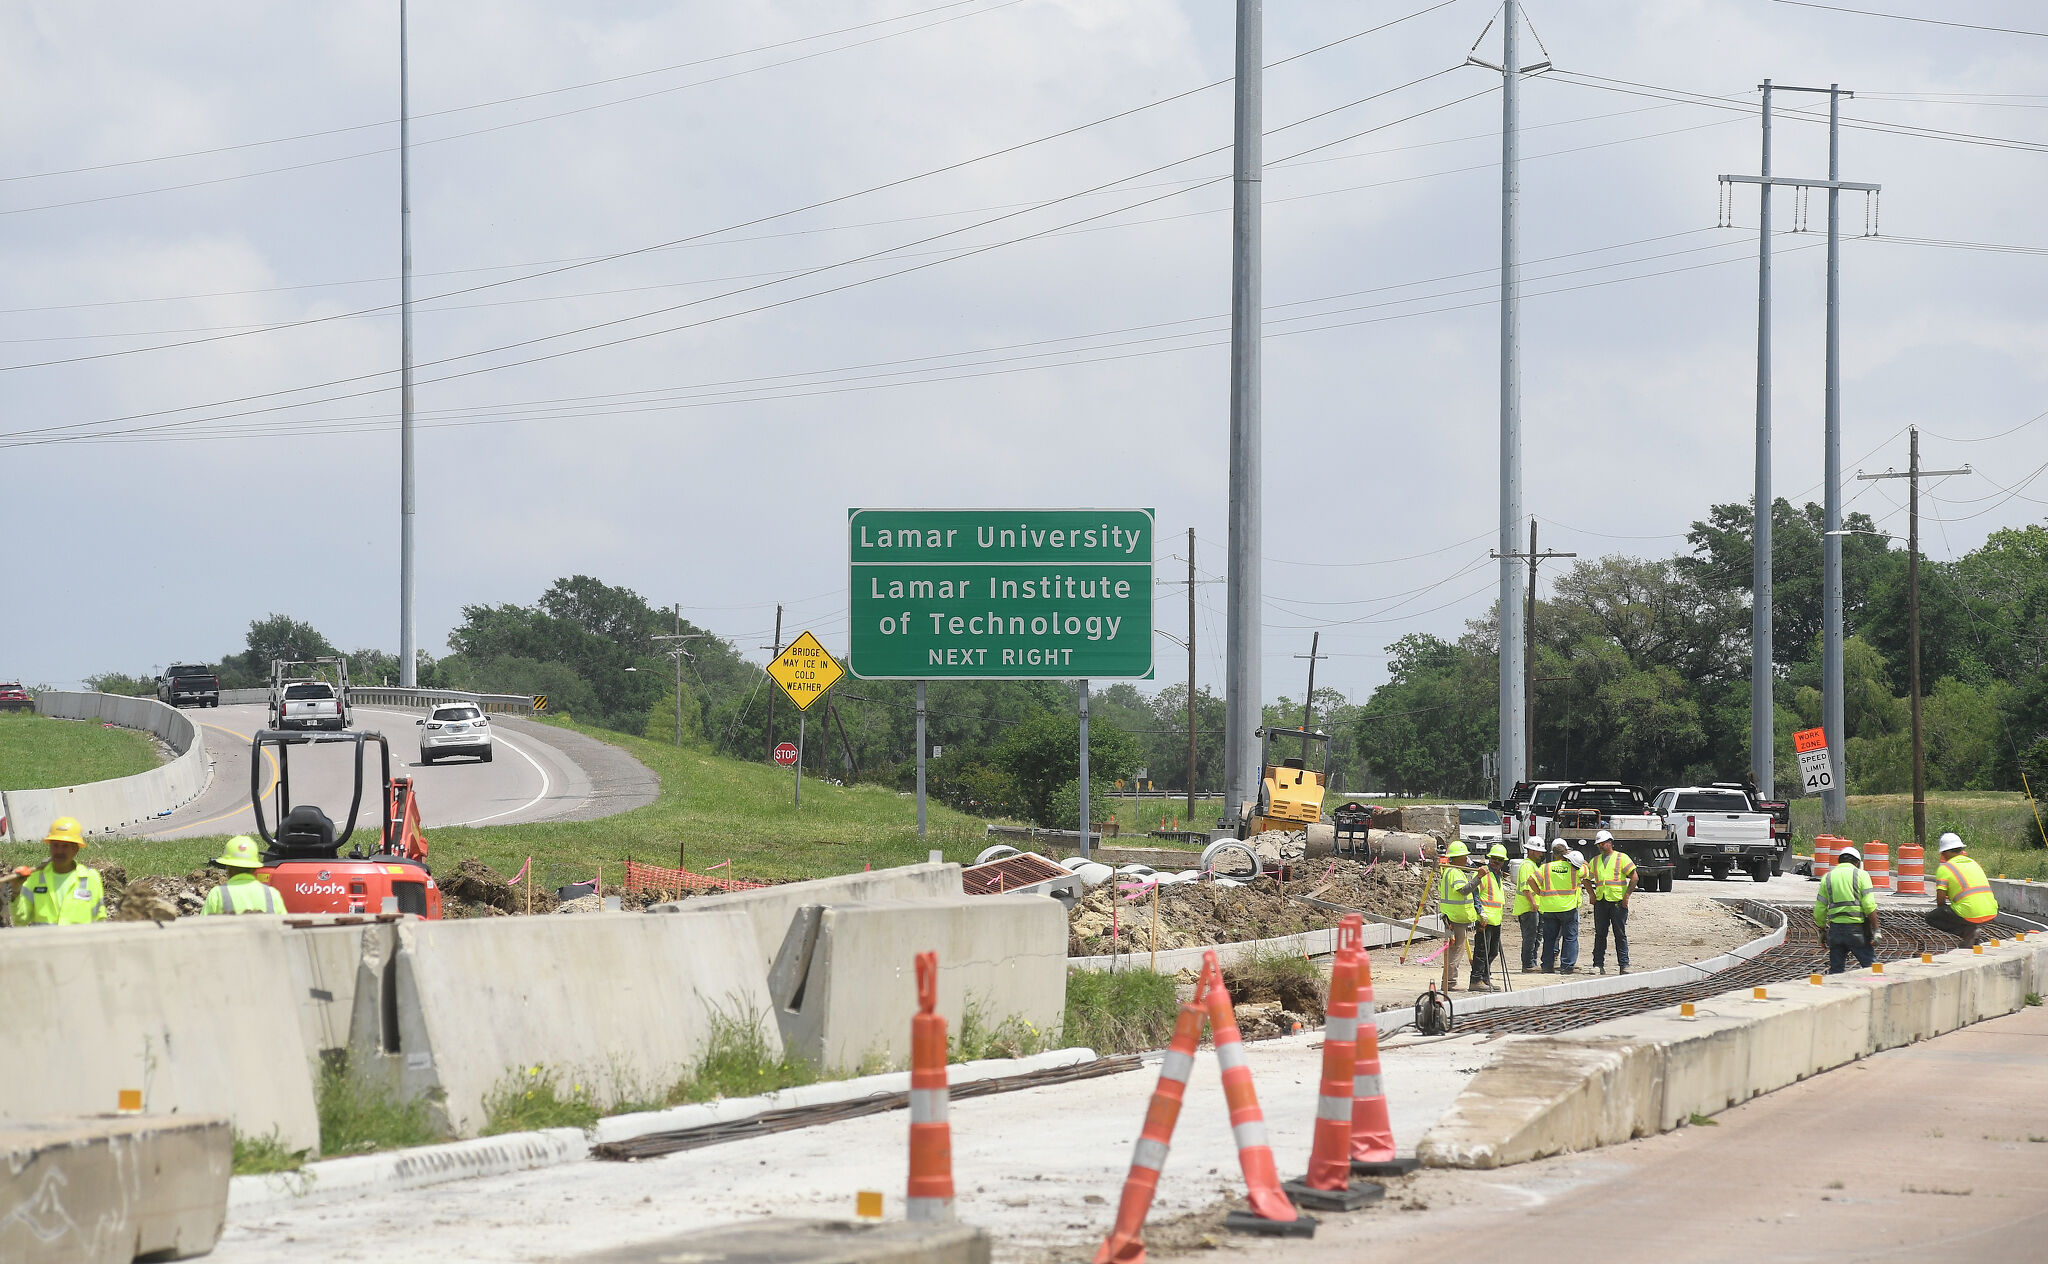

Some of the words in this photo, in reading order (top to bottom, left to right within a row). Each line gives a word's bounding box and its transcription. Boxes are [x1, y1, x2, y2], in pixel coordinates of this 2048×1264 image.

[860, 525, 958, 548] Lamar
[977, 523, 1141, 554] University
[871, 577, 970, 599] Lamar
[990, 574, 1131, 599] Institute
[879, 612, 911, 635] of
[929, 611, 1122, 641] Technology
[792, 647, 820, 657] BRIDGE
[928, 648, 988, 666] NEXT
[1002, 648, 1074, 666] RIGHT
[782, 658, 799, 668] MAY
[803, 660, 816, 669] ICE
[820, 660, 828, 669] IN
[794, 670, 815, 680] COLD
[786, 681, 822, 692] WEATHER
[1797, 731, 1820, 741] WORK
[1800, 740, 1822, 750] ZONE
[775, 749, 796, 760] STOP
[1801, 753, 1827, 764] SPEED
[1805, 763, 1825, 773] LIMIT
[1806, 772, 1831, 788] 40
[295, 882, 346, 895] Kubota
